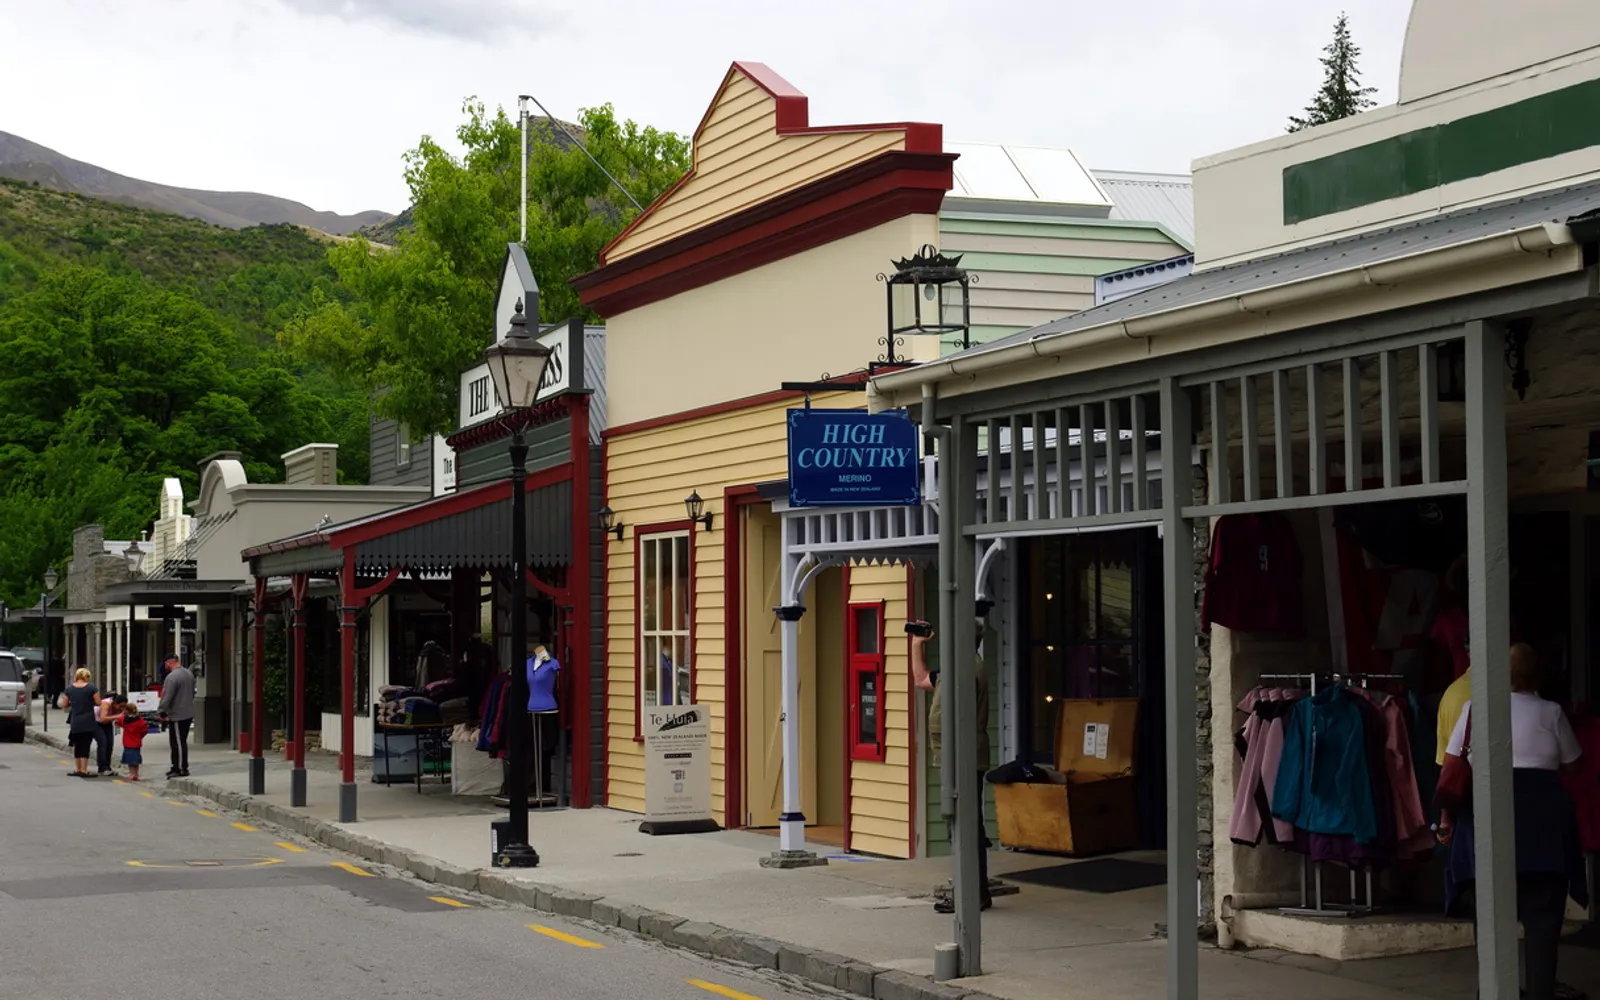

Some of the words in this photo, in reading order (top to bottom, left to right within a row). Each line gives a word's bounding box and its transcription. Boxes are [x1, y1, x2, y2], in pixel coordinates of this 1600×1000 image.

[469, 374, 489, 417] THE
[821, 423, 887, 444] HIGH
[797, 447, 911, 469] COUNTRY
[838, 474, 872, 483] MERINO
[649, 713, 663, 725] Te
